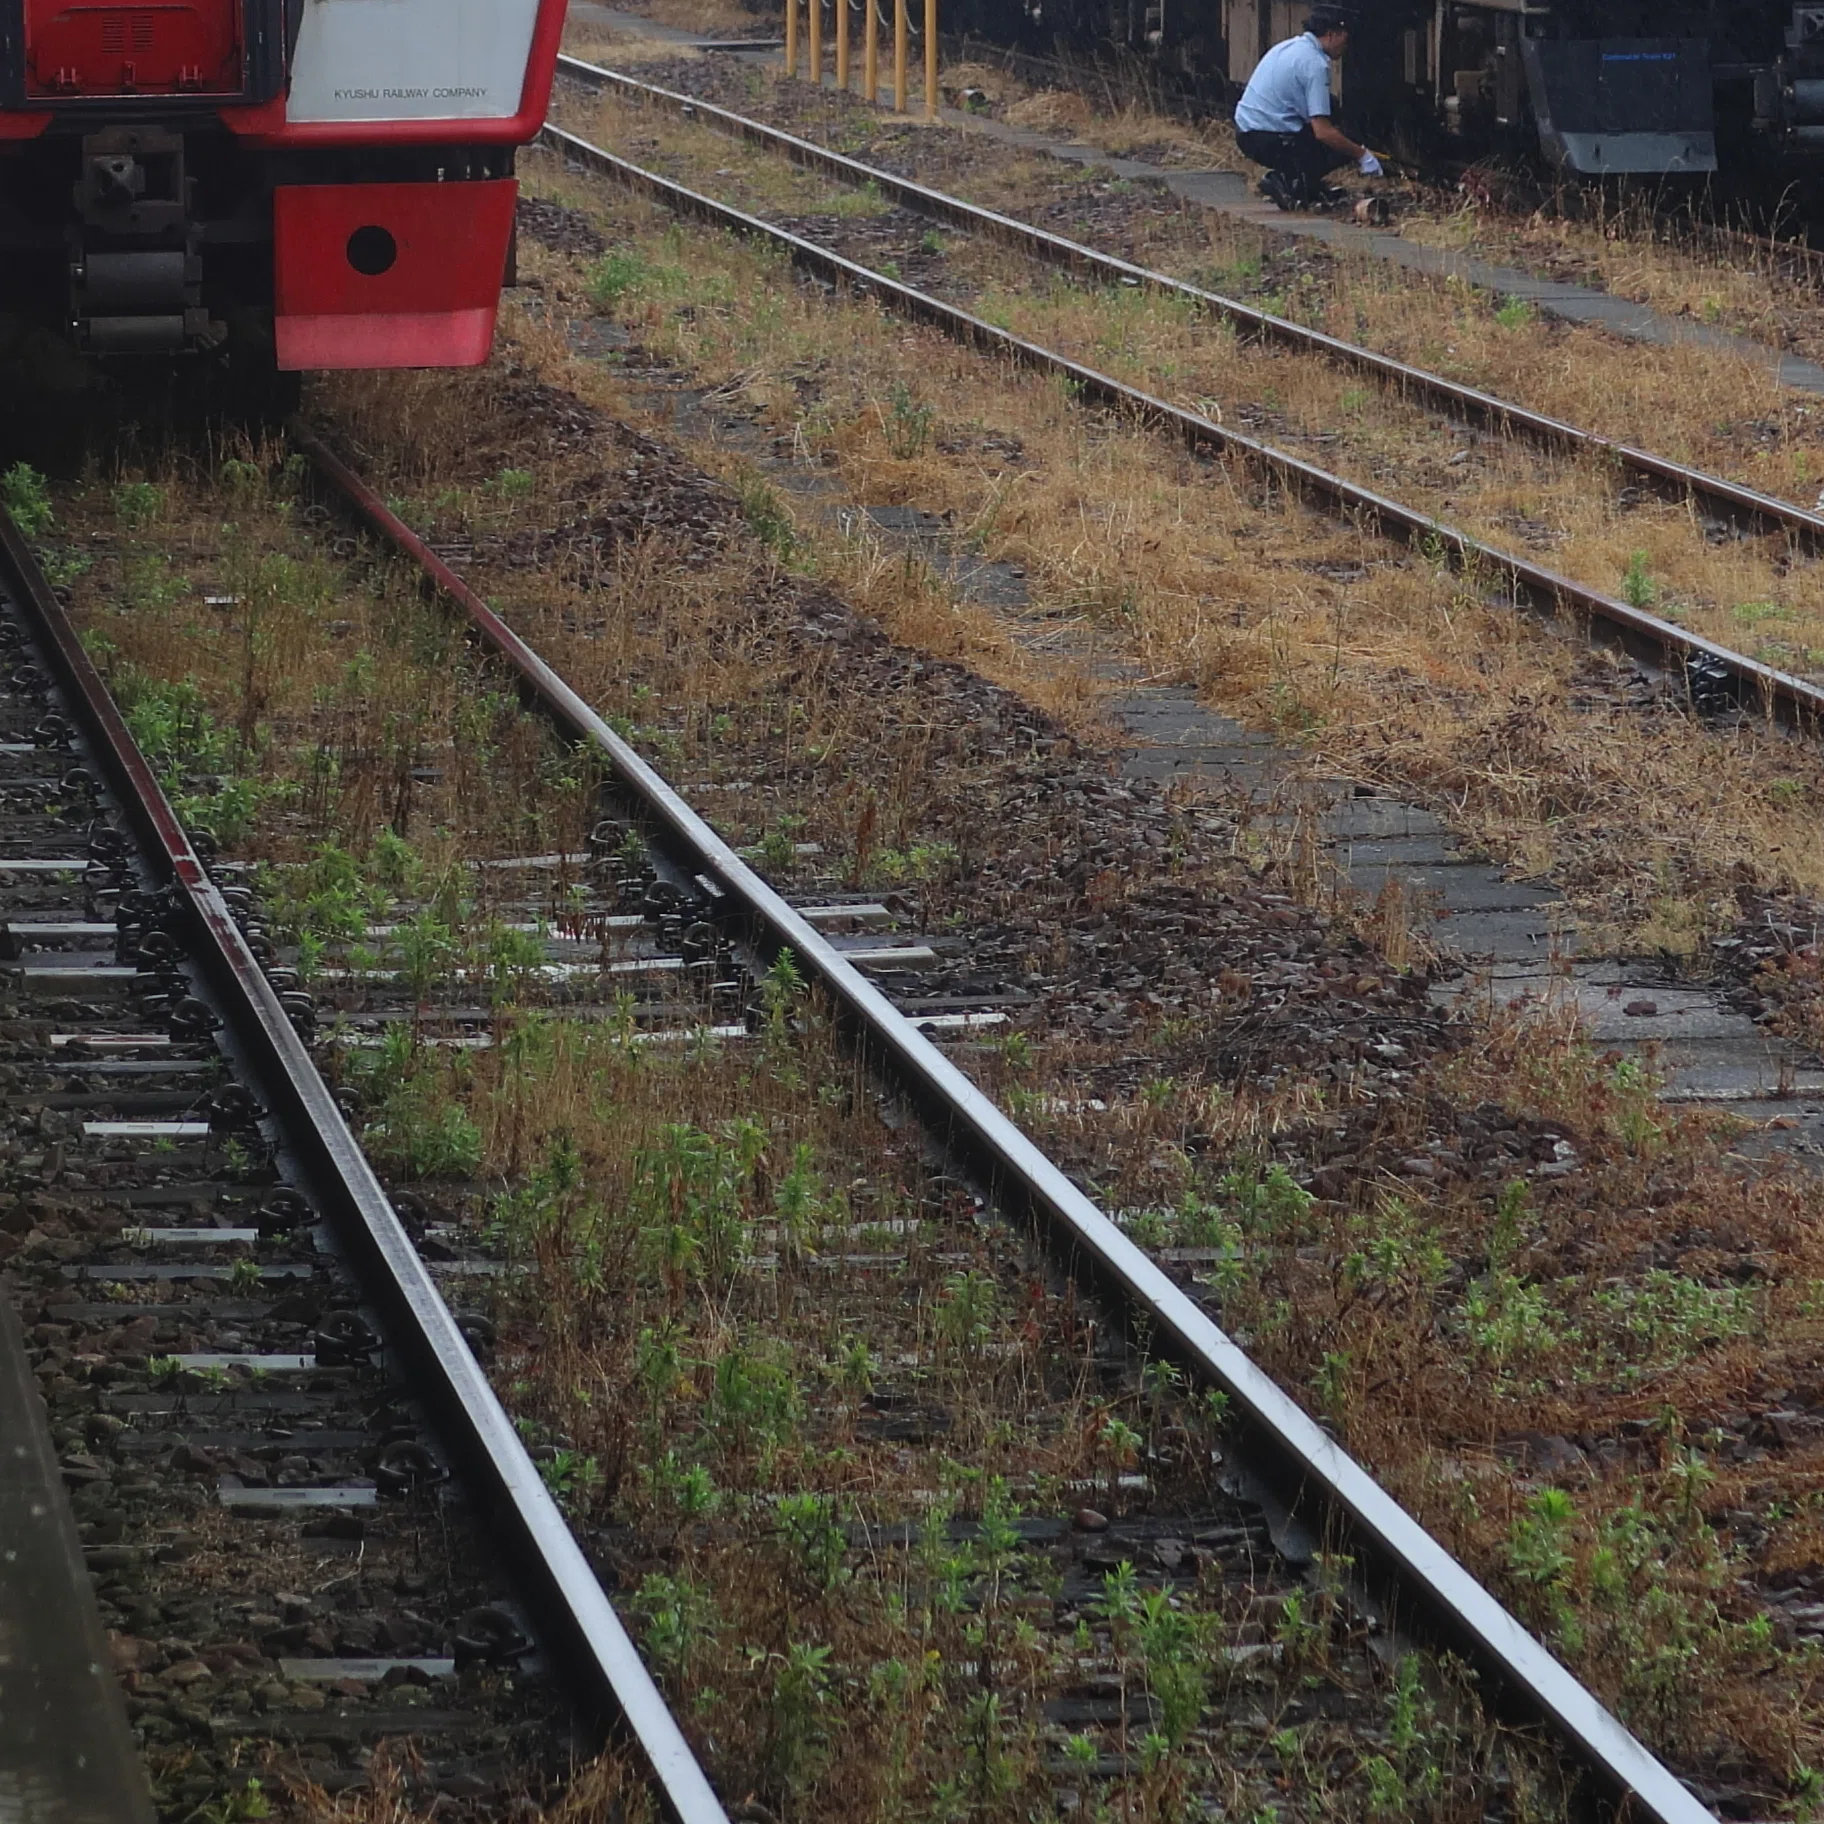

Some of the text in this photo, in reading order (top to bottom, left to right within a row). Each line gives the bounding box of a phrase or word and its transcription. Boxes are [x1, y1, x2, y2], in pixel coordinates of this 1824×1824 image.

[334, 88, 488, 100] KYUSHU RAILWAY COMPANY
